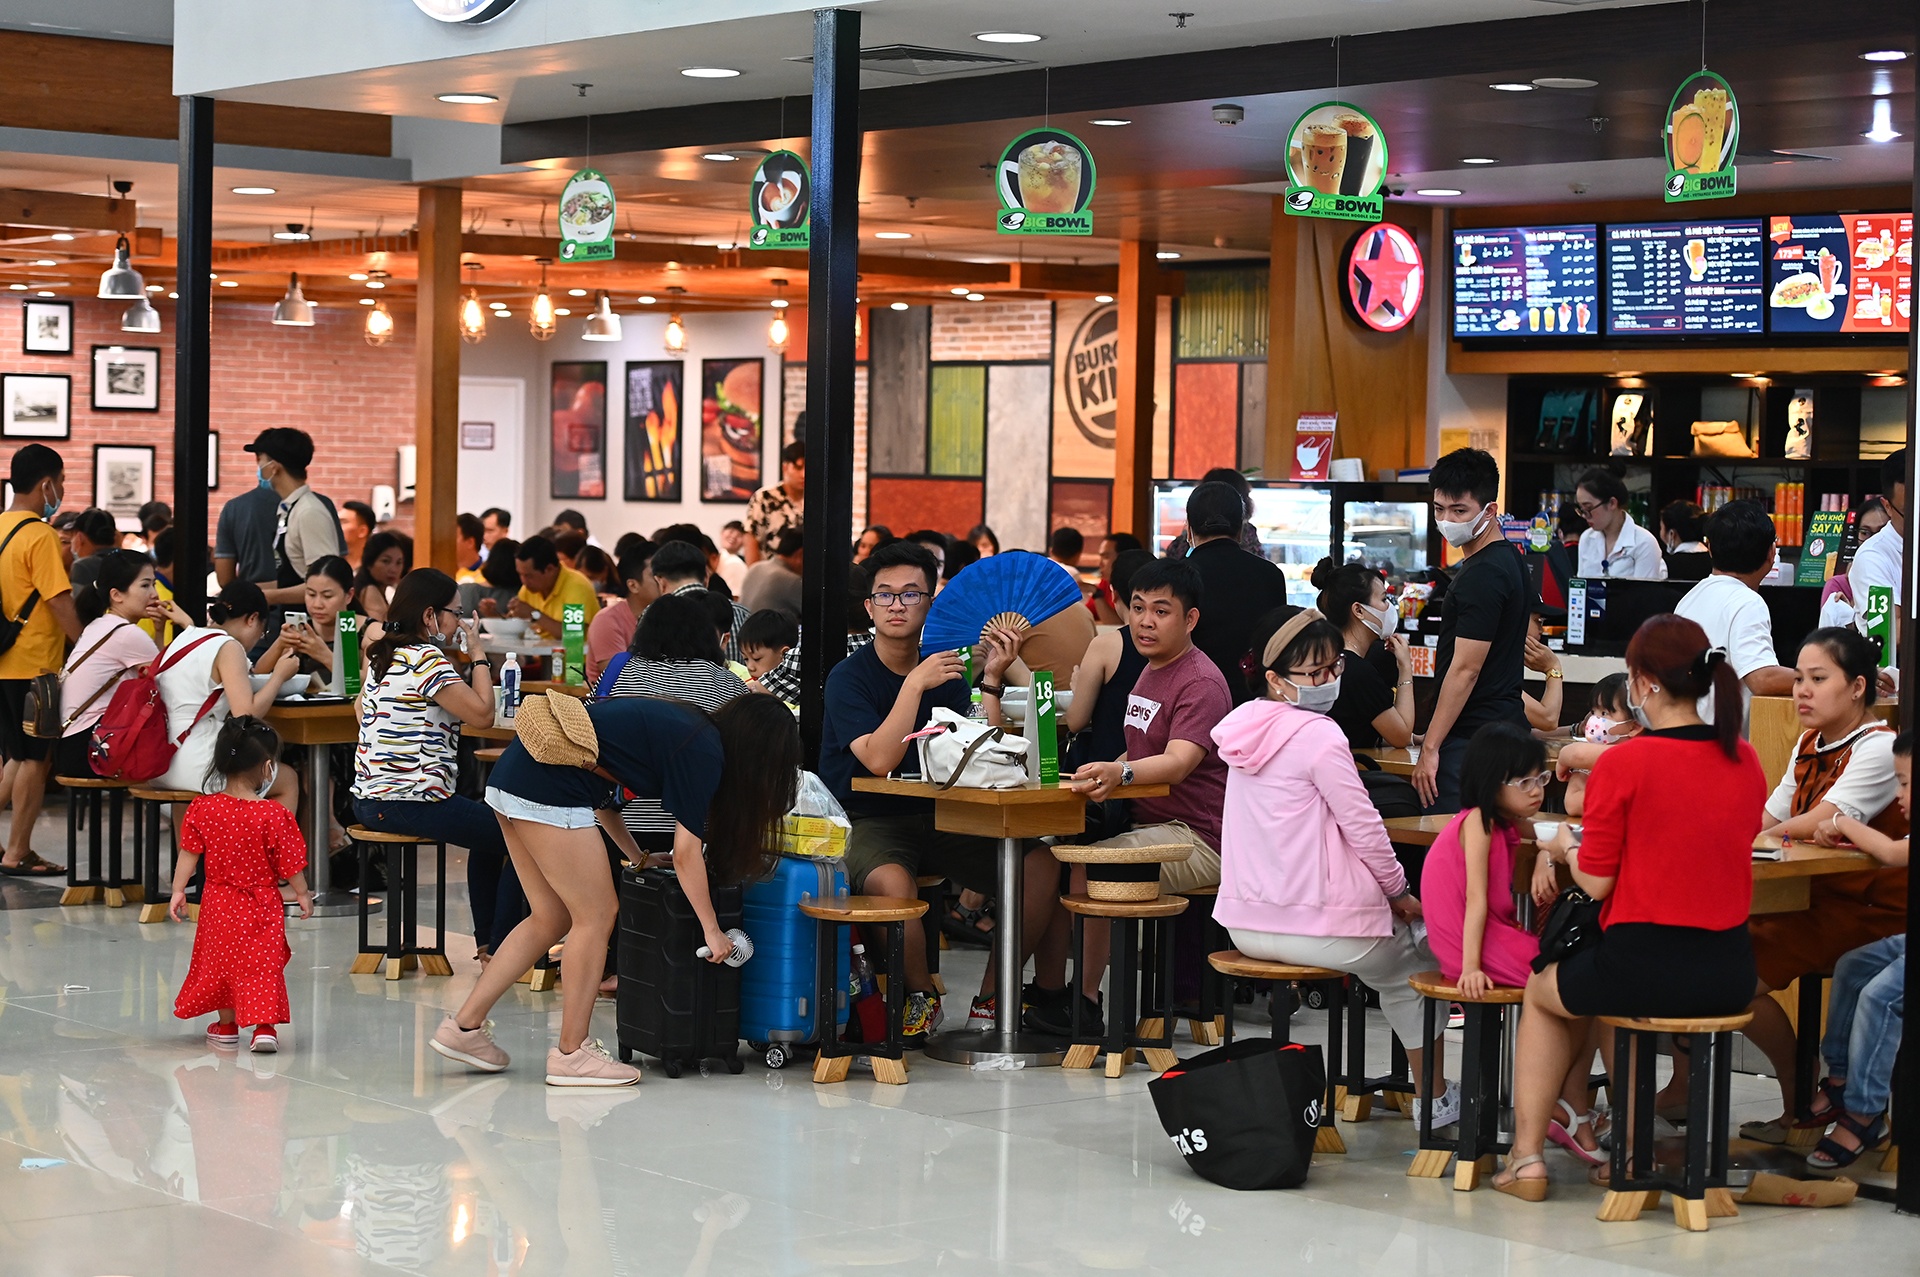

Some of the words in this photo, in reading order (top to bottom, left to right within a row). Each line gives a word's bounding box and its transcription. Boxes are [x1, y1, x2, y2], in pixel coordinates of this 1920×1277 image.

[1681, 176, 1734, 192] BIGBOWL
[1311, 197, 1381, 214] BIGBOWL
[1023, 217, 1090, 228] BIGBOWL
[1773, 222, 1789, 233] NEW
[1811, 523, 1831, 534] SAY
[1832, 523, 1843, 534] N
[1868, 594, 1889, 614] 13
[563, 609, 584, 624] 36
[340, 617, 356, 632] 52
[1411, 659, 1429, 675] RE
[1035, 680, 1053, 700] 18
